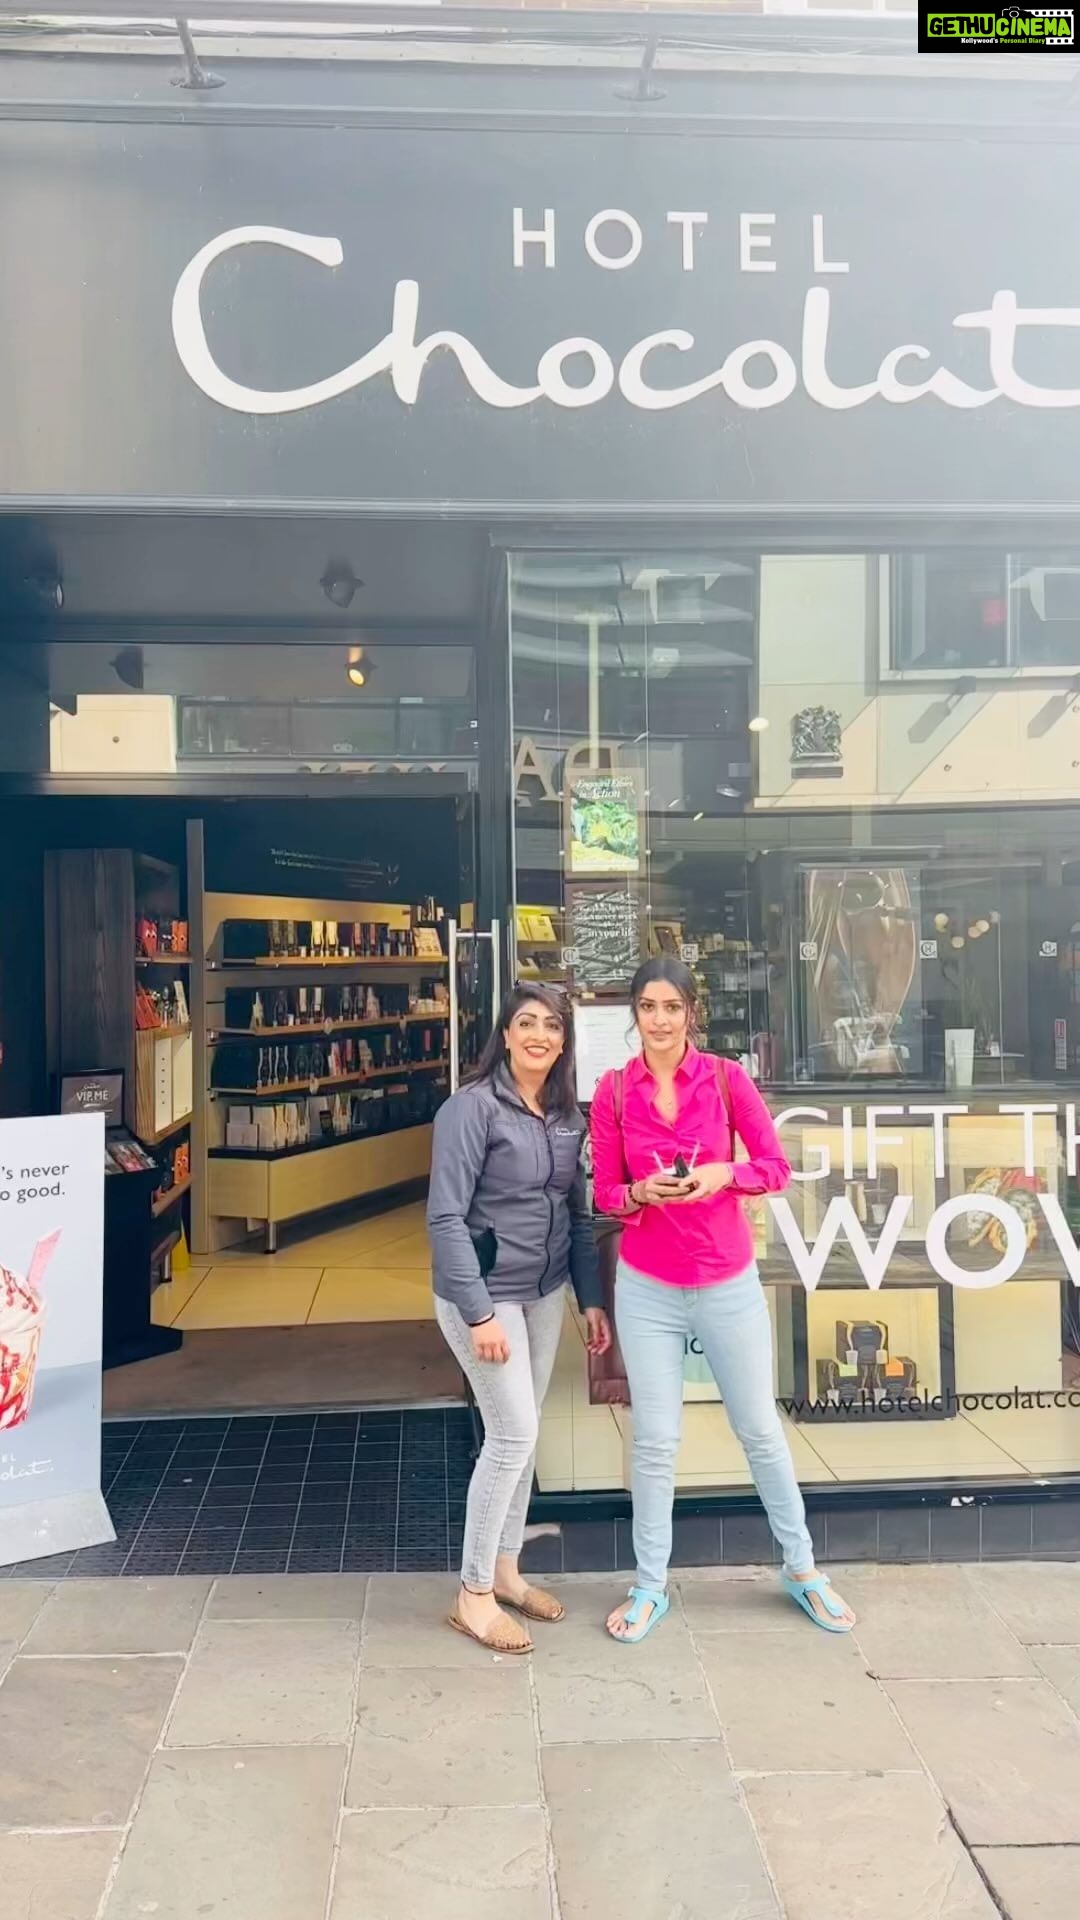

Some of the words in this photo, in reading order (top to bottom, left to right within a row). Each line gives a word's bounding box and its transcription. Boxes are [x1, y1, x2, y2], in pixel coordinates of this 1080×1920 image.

[512, 207, 850, 273] HOTEL
[171, 225, 1080, 414] Chocolat
[20, 1165, 70, 1179] never
[774, 1104, 968, 1181] GIFT
[17, 1181, 65, 1204] good.
